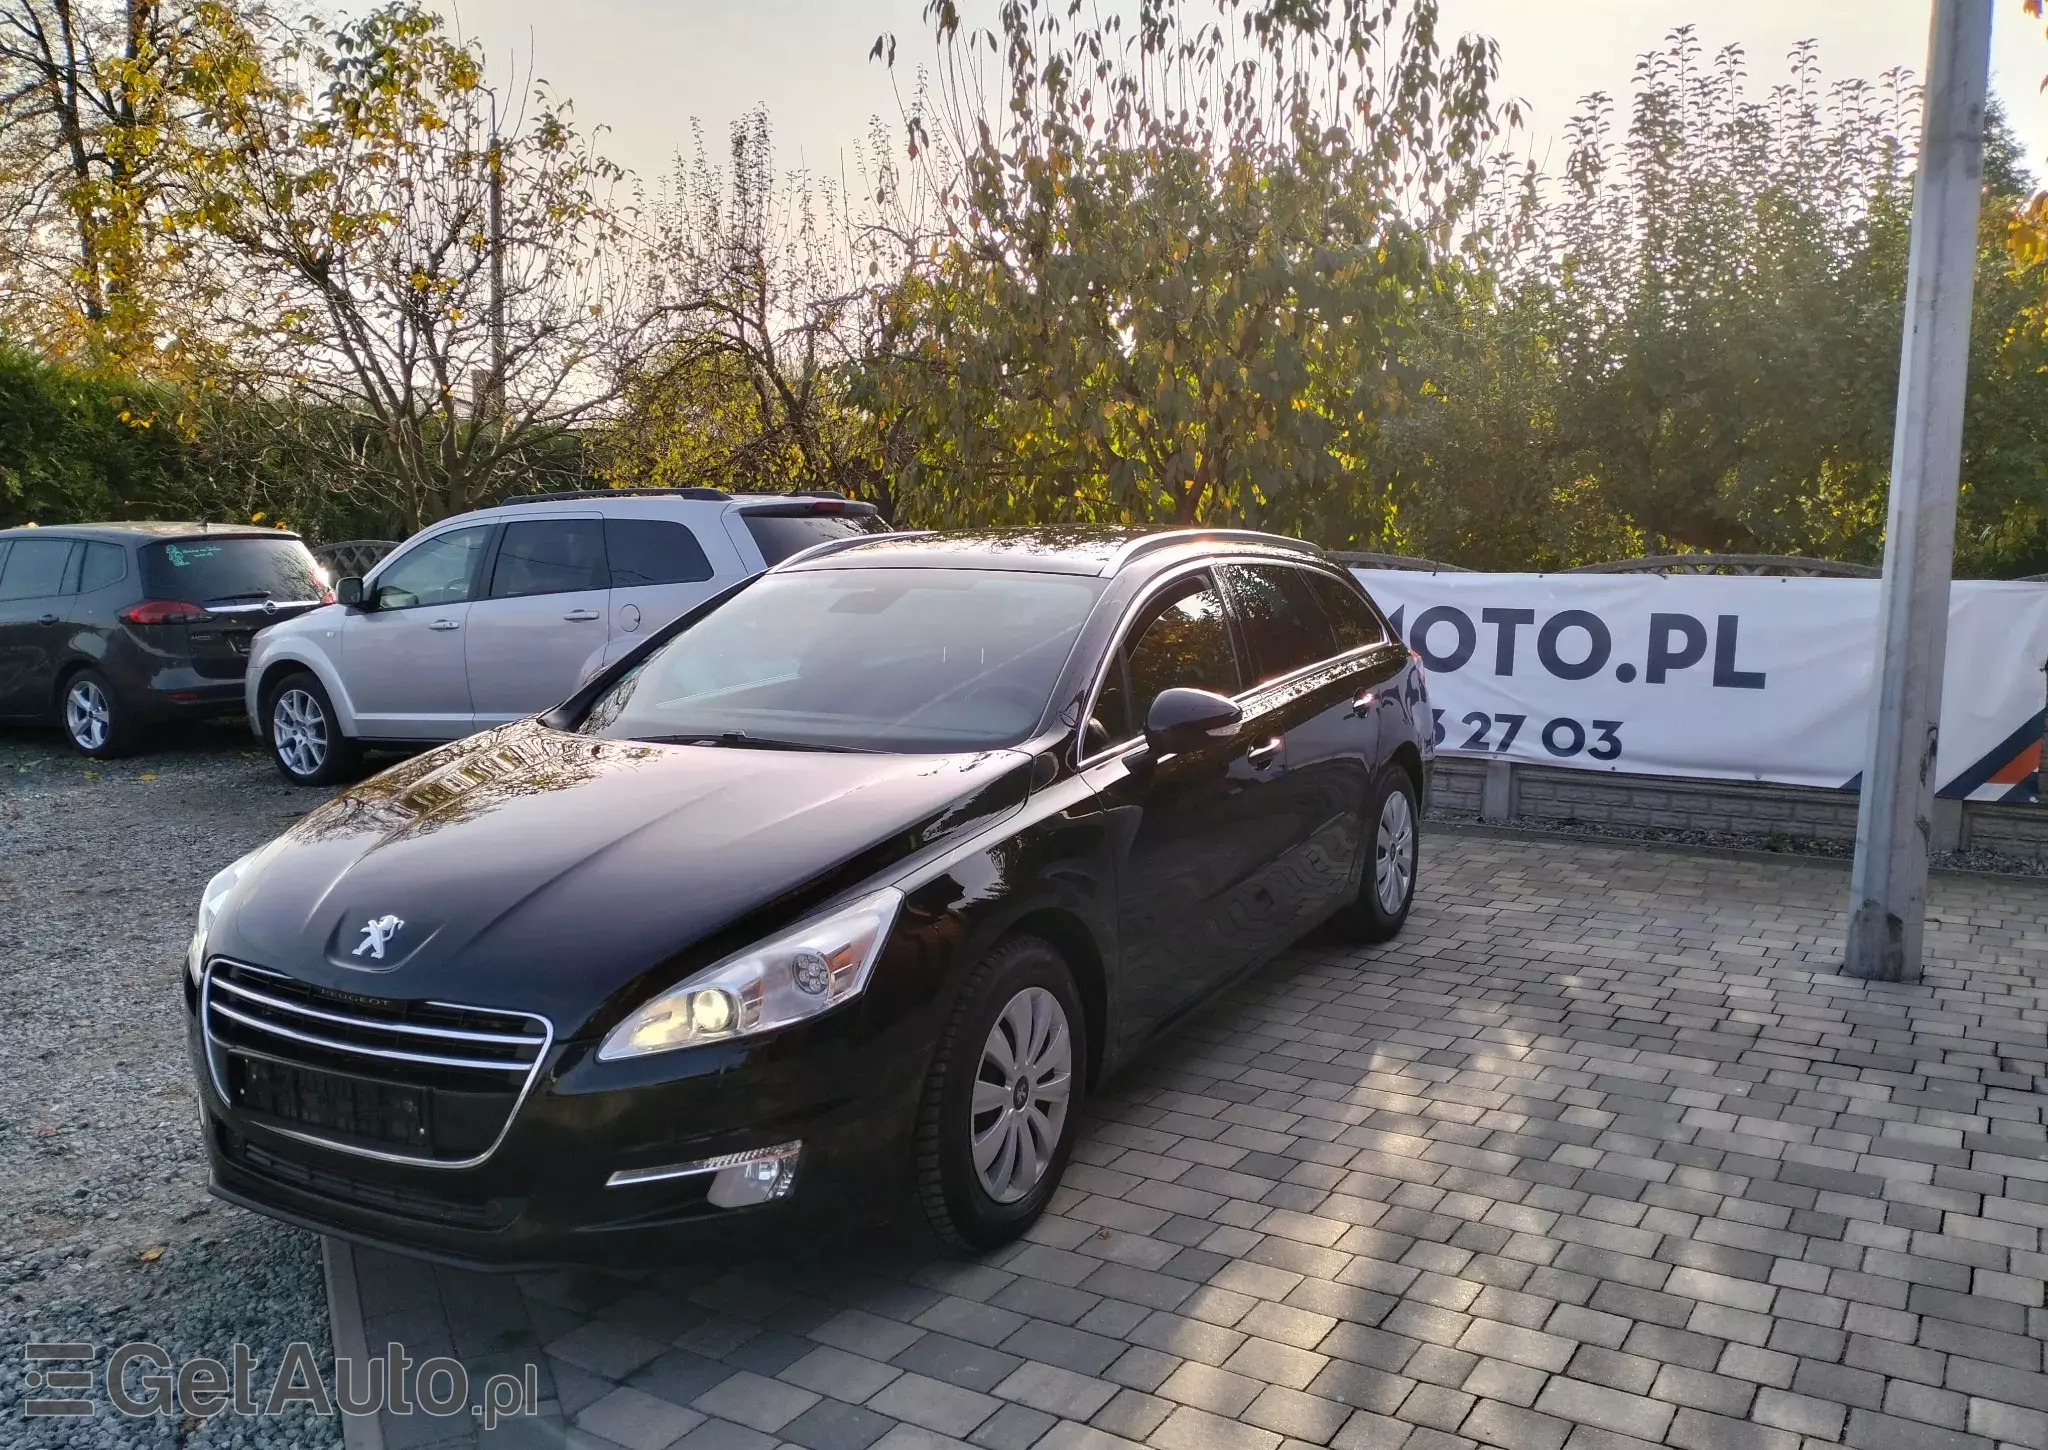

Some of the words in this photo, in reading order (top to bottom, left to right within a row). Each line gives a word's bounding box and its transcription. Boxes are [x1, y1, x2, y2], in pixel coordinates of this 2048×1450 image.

[1387, 603, 1767, 690] OTO.PL
[1458, 711, 1528, 753] 27
[1541, 717, 1625, 761] 03
[320, 987, 391, 1006] PEUGEOT
